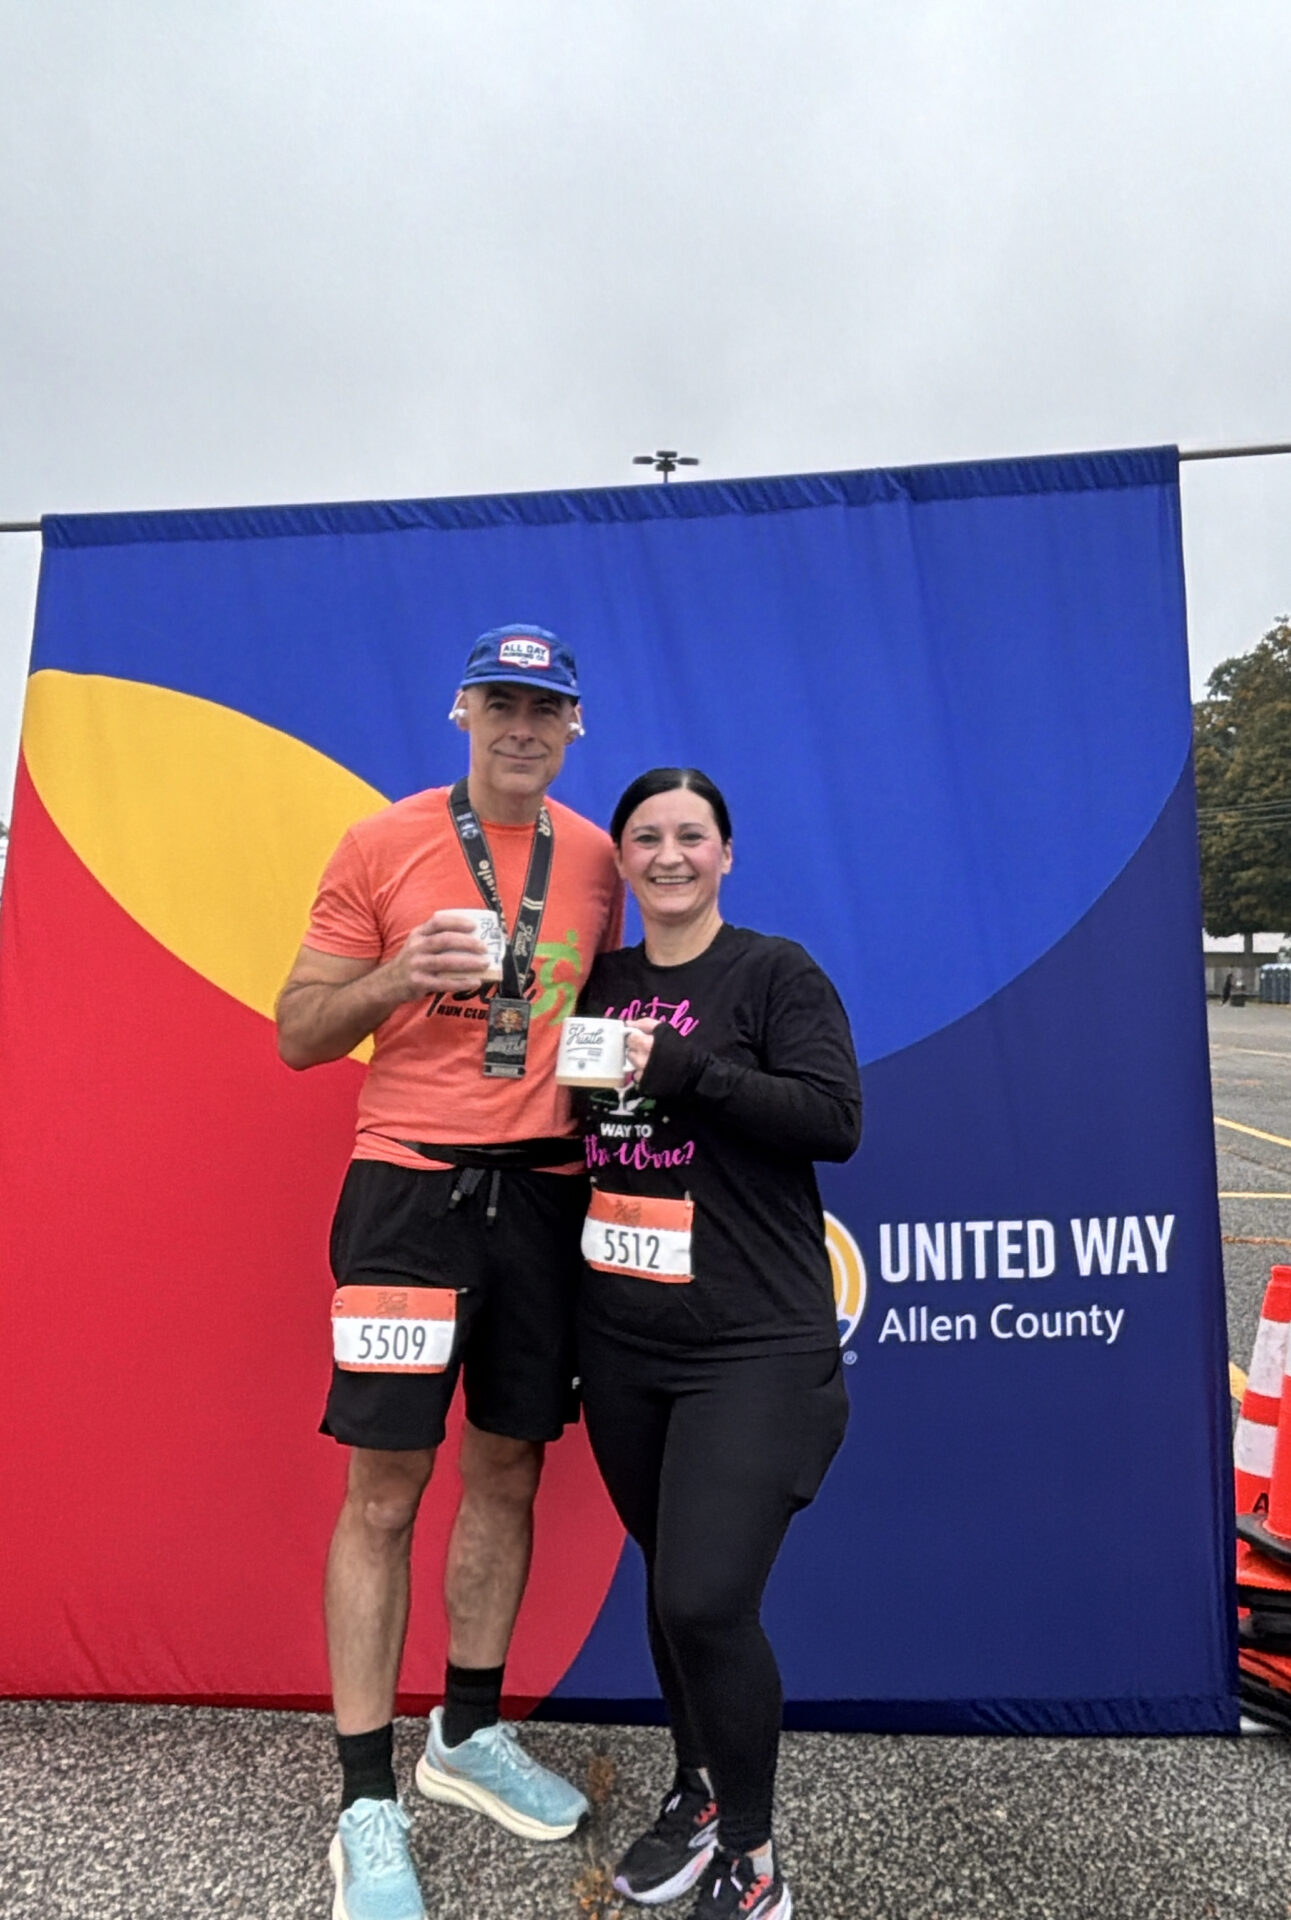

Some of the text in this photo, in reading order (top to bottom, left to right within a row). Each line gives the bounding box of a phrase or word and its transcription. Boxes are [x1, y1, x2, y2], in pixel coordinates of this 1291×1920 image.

[503, 644, 546, 655] ALL DAY
[437, 1004, 489, 1021] RUN CLU
[600, 1122, 654, 1138] WAY TO
[603, 1228, 660, 1269] 5512
[879, 1214, 1175, 1283] UNITED WAY
[357, 1324, 426, 1361] 5509
[878, 1303, 1125, 1345] Allen County
